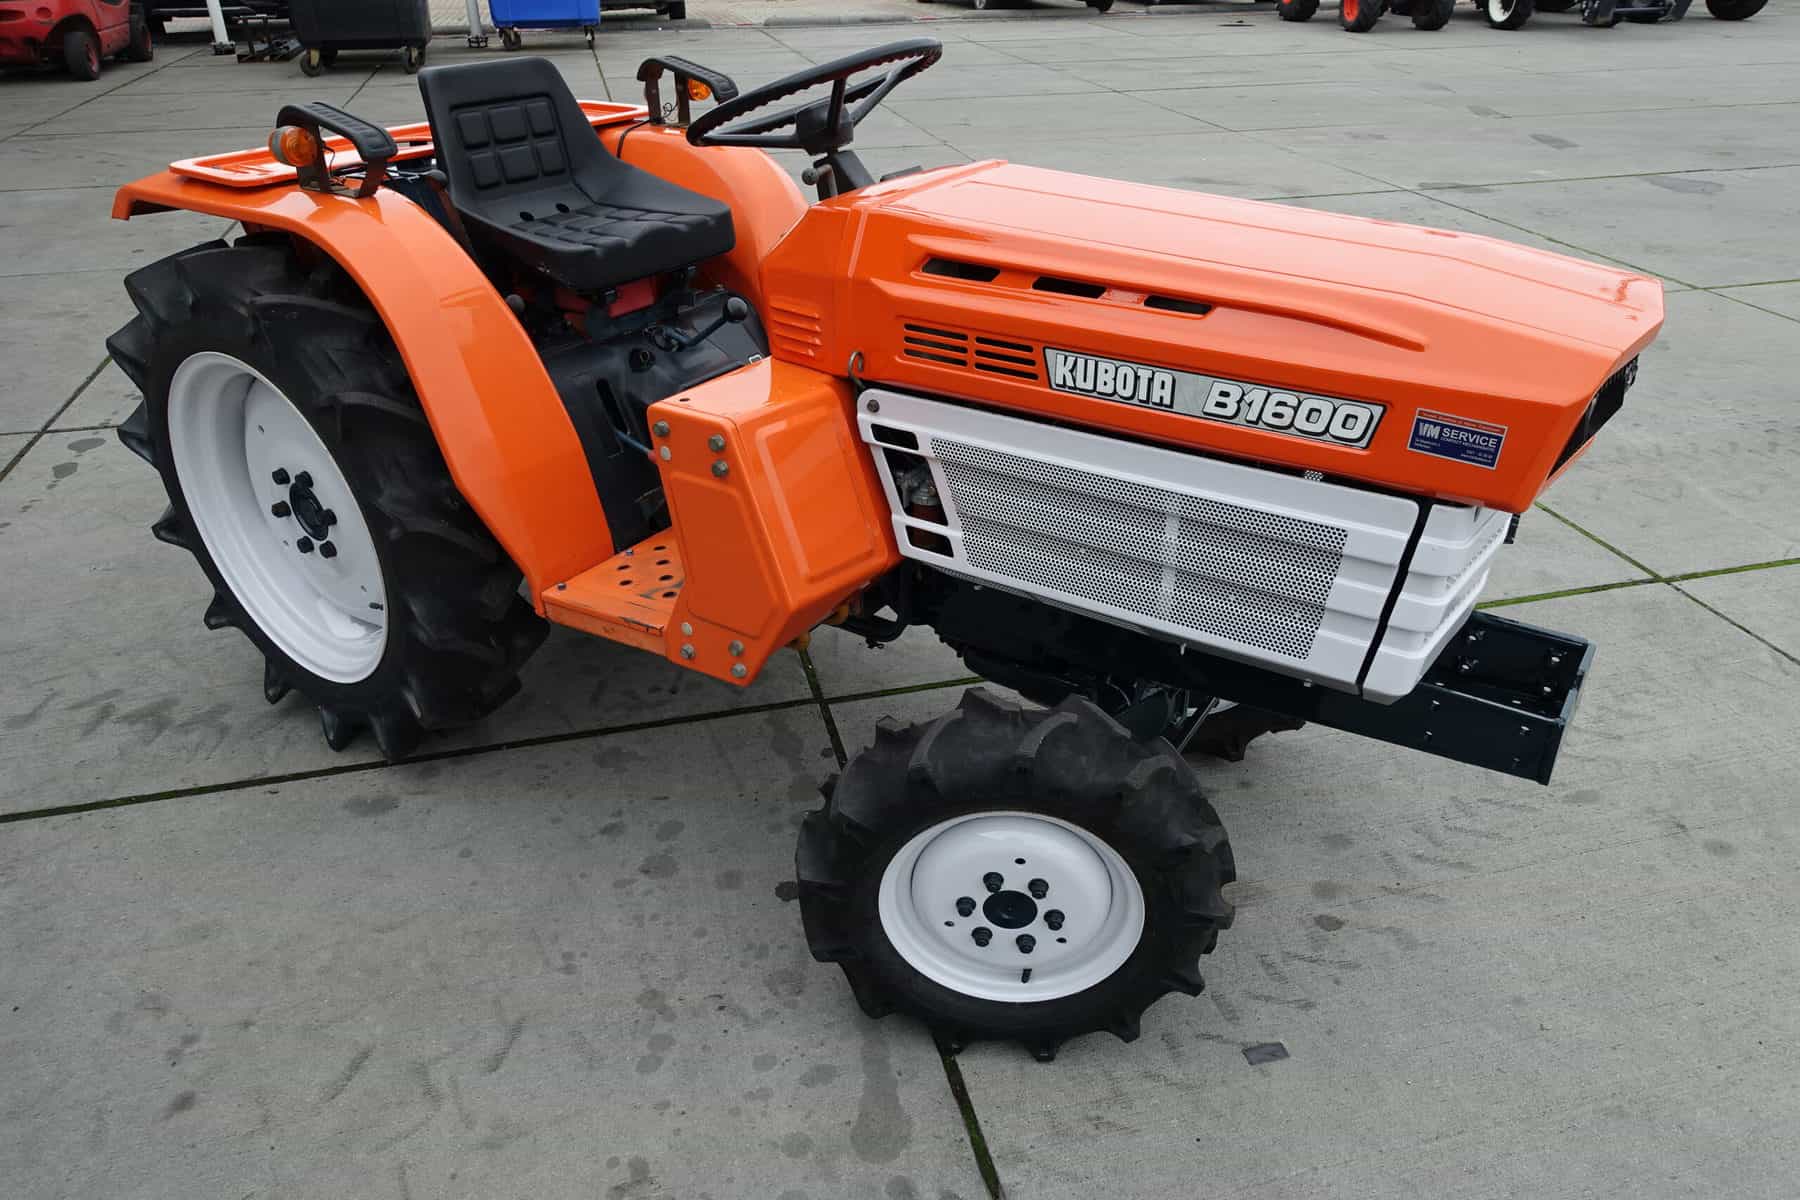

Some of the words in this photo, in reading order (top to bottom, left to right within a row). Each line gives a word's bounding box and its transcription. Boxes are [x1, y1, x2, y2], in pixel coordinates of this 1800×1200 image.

[1055, 353, 1175, 408] KUBOTA
[1202, 381, 1374, 442] B1600
[1441, 427, 1498, 448] SERVICE
